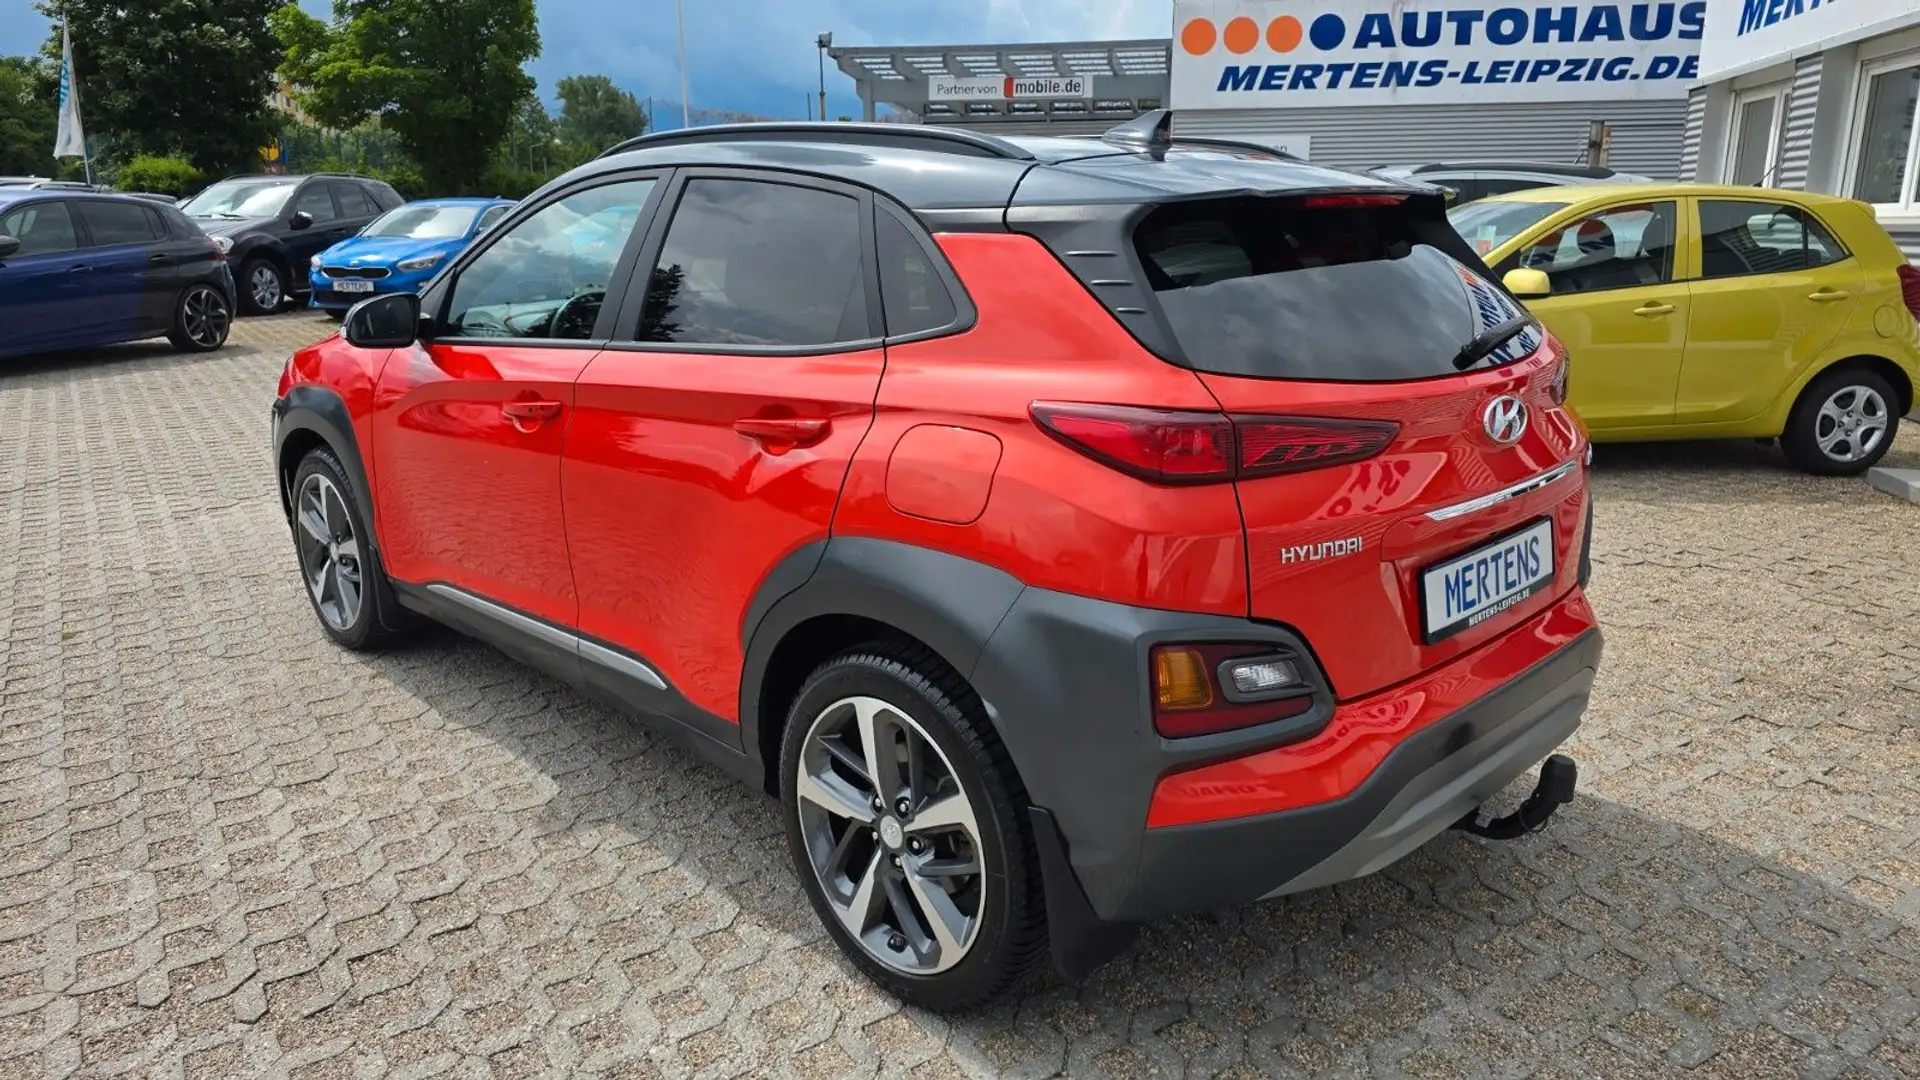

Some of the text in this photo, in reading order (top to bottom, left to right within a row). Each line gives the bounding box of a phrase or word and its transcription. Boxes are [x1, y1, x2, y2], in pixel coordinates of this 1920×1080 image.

[1352, 2, 1706, 49] AUTOHAUS
[936, 79, 1081, 95] Partner von mobile.de
[1216, 55, 1700, 92] MERTENS-LEIPZIG.DE
[1281, 536, 1362, 565] HYUNDAI
[1445, 535, 1540, 618] MERTENS
